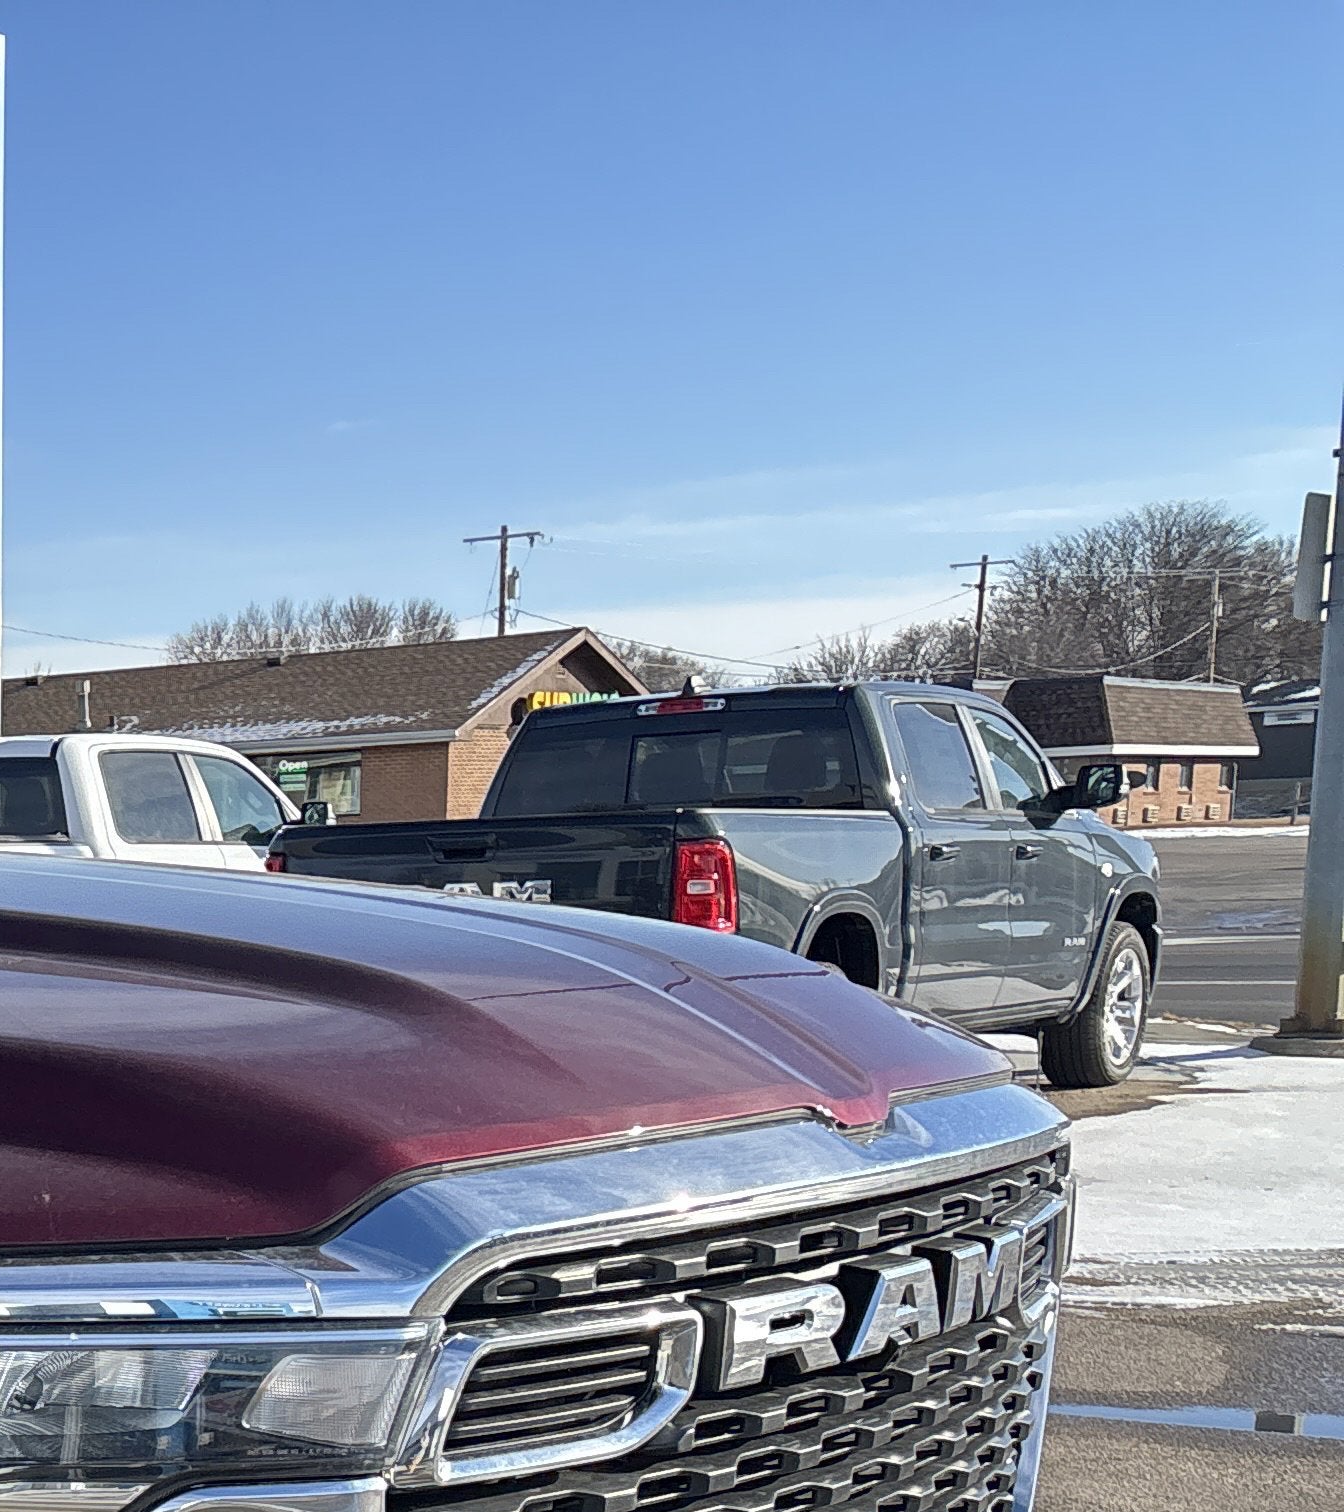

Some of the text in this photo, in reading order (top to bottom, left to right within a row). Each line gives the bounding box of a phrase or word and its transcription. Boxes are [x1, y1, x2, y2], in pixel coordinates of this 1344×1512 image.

[278, 760, 308, 772] Open
[444, 880, 552, 902] AM
[710, 1228, 1024, 1391] RAM
